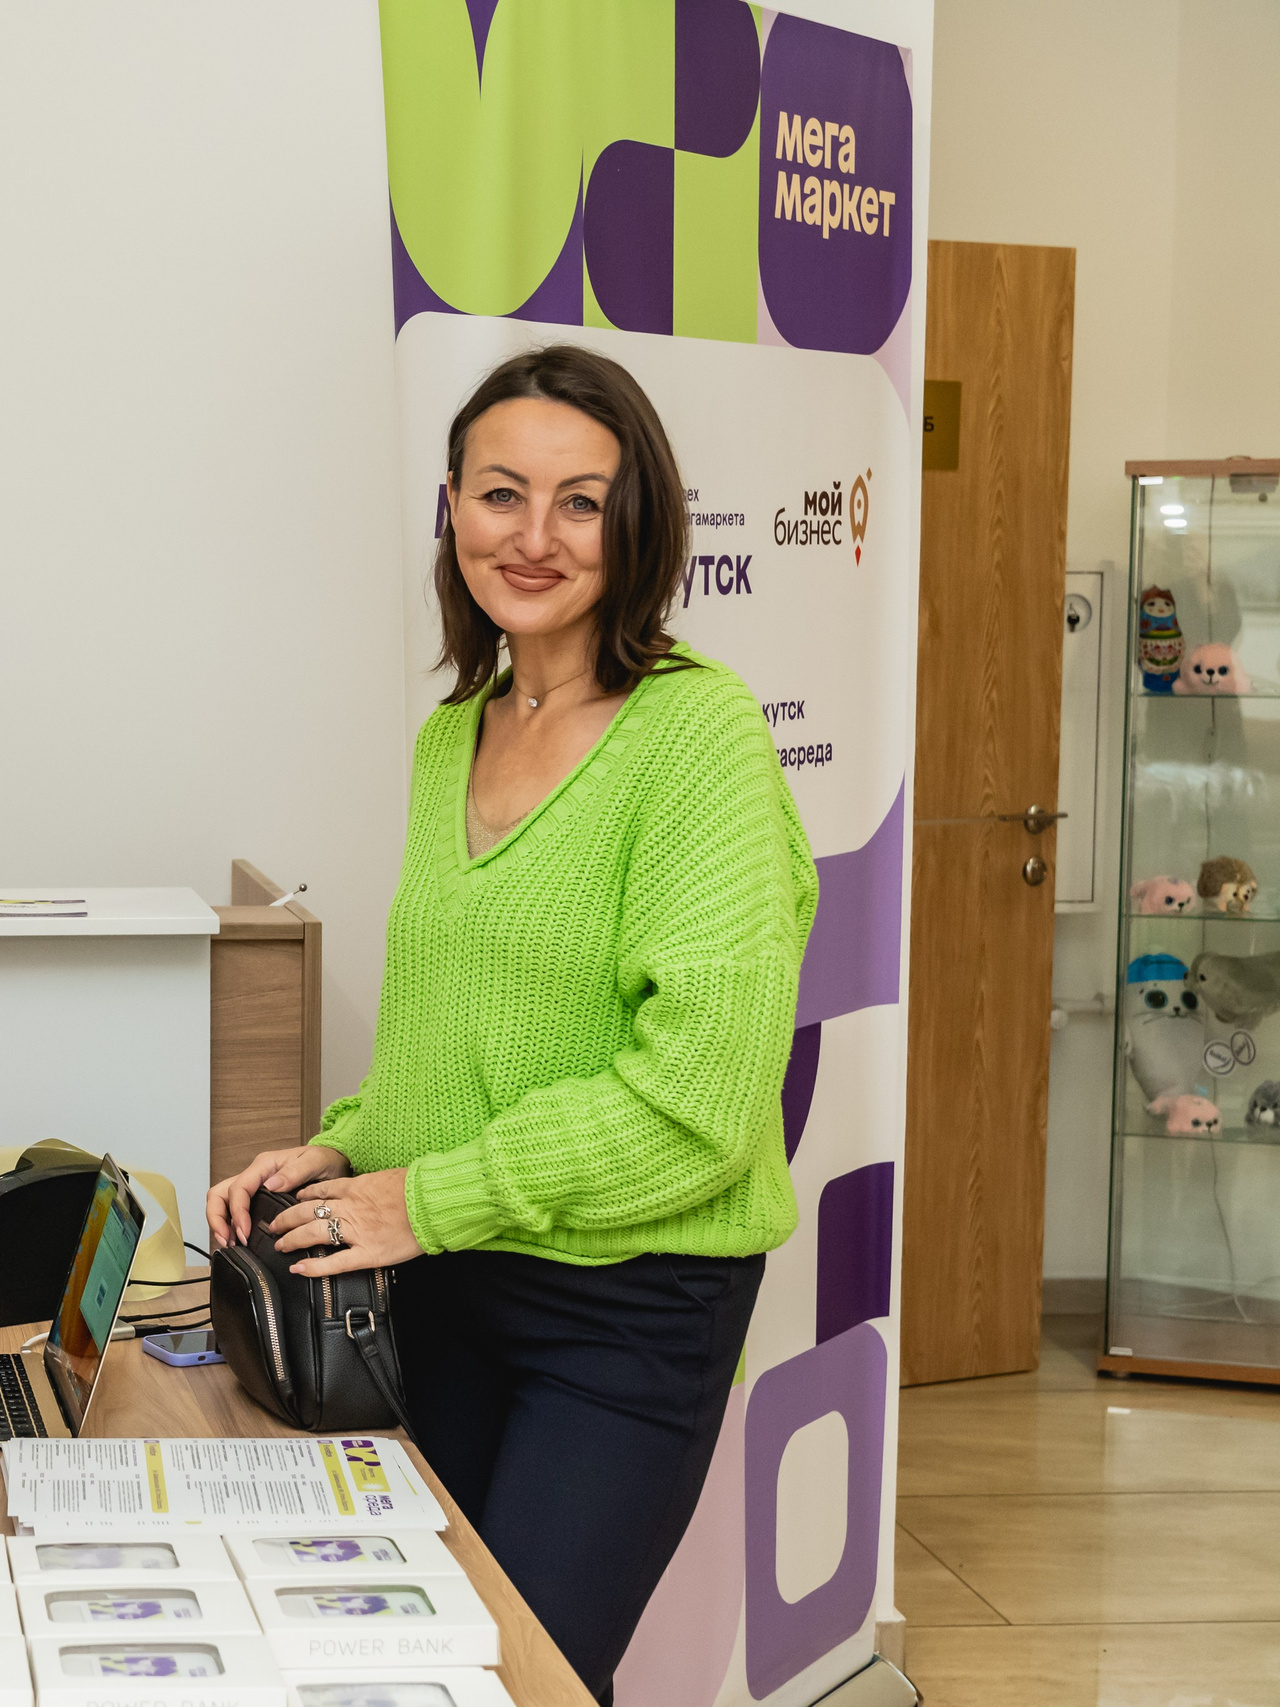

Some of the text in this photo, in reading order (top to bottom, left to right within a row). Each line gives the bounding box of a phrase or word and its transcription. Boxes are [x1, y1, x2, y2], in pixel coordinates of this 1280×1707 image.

[775, 111, 856, 175] мега
[774, 170, 896, 240] маркет
[803, 481, 842, 516] мой
[774, 507, 842, 546] бизнес
[682, 554, 753, 609] утск
[761, 700, 806, 728] кутск
[776, 742, 833, 771] асреда
[308, 1637, 455, 1657] POWER BANK
